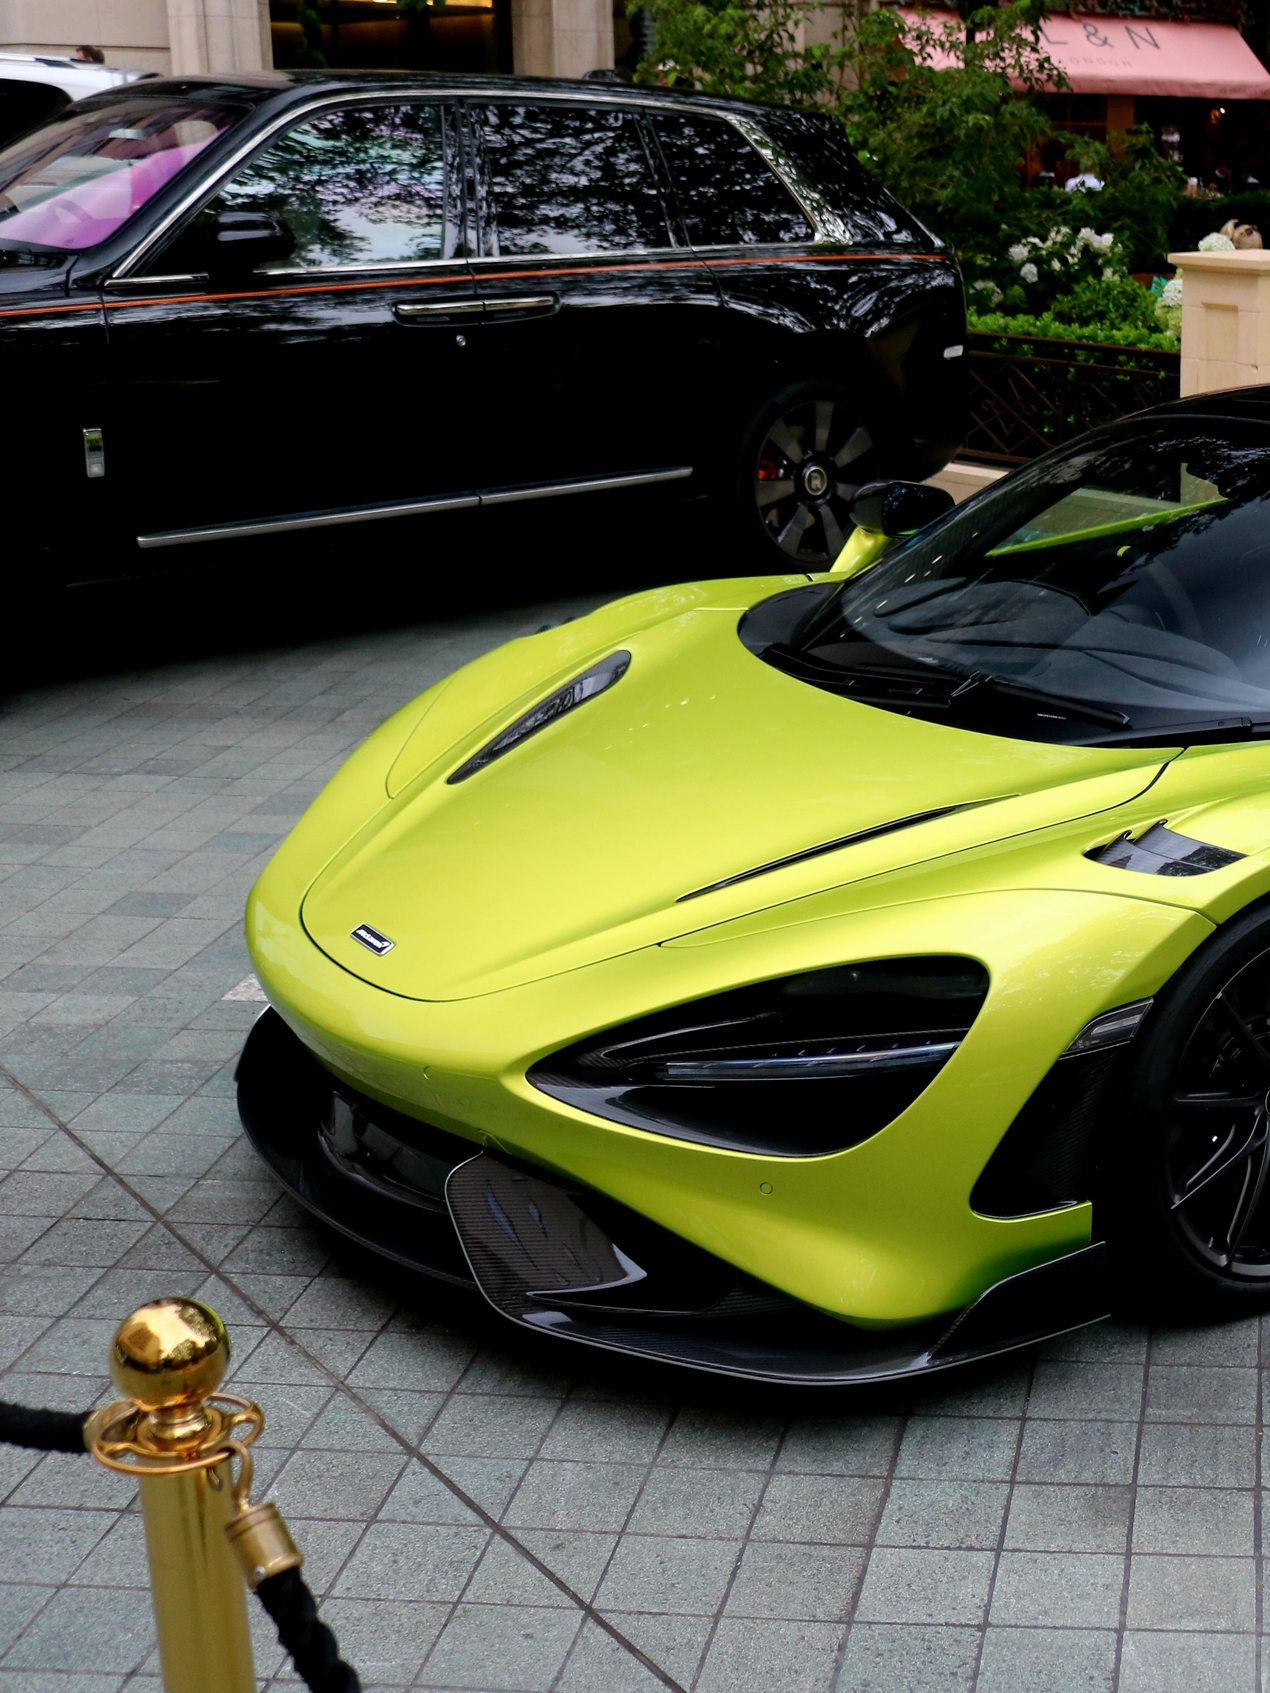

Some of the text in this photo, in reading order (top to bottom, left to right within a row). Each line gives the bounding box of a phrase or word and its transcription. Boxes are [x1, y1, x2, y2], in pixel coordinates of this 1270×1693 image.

[1083, 22, 1114, 48] &
[1124, 25, 1161, 50] N
[1067, 56, 1133, 68] ONDON
